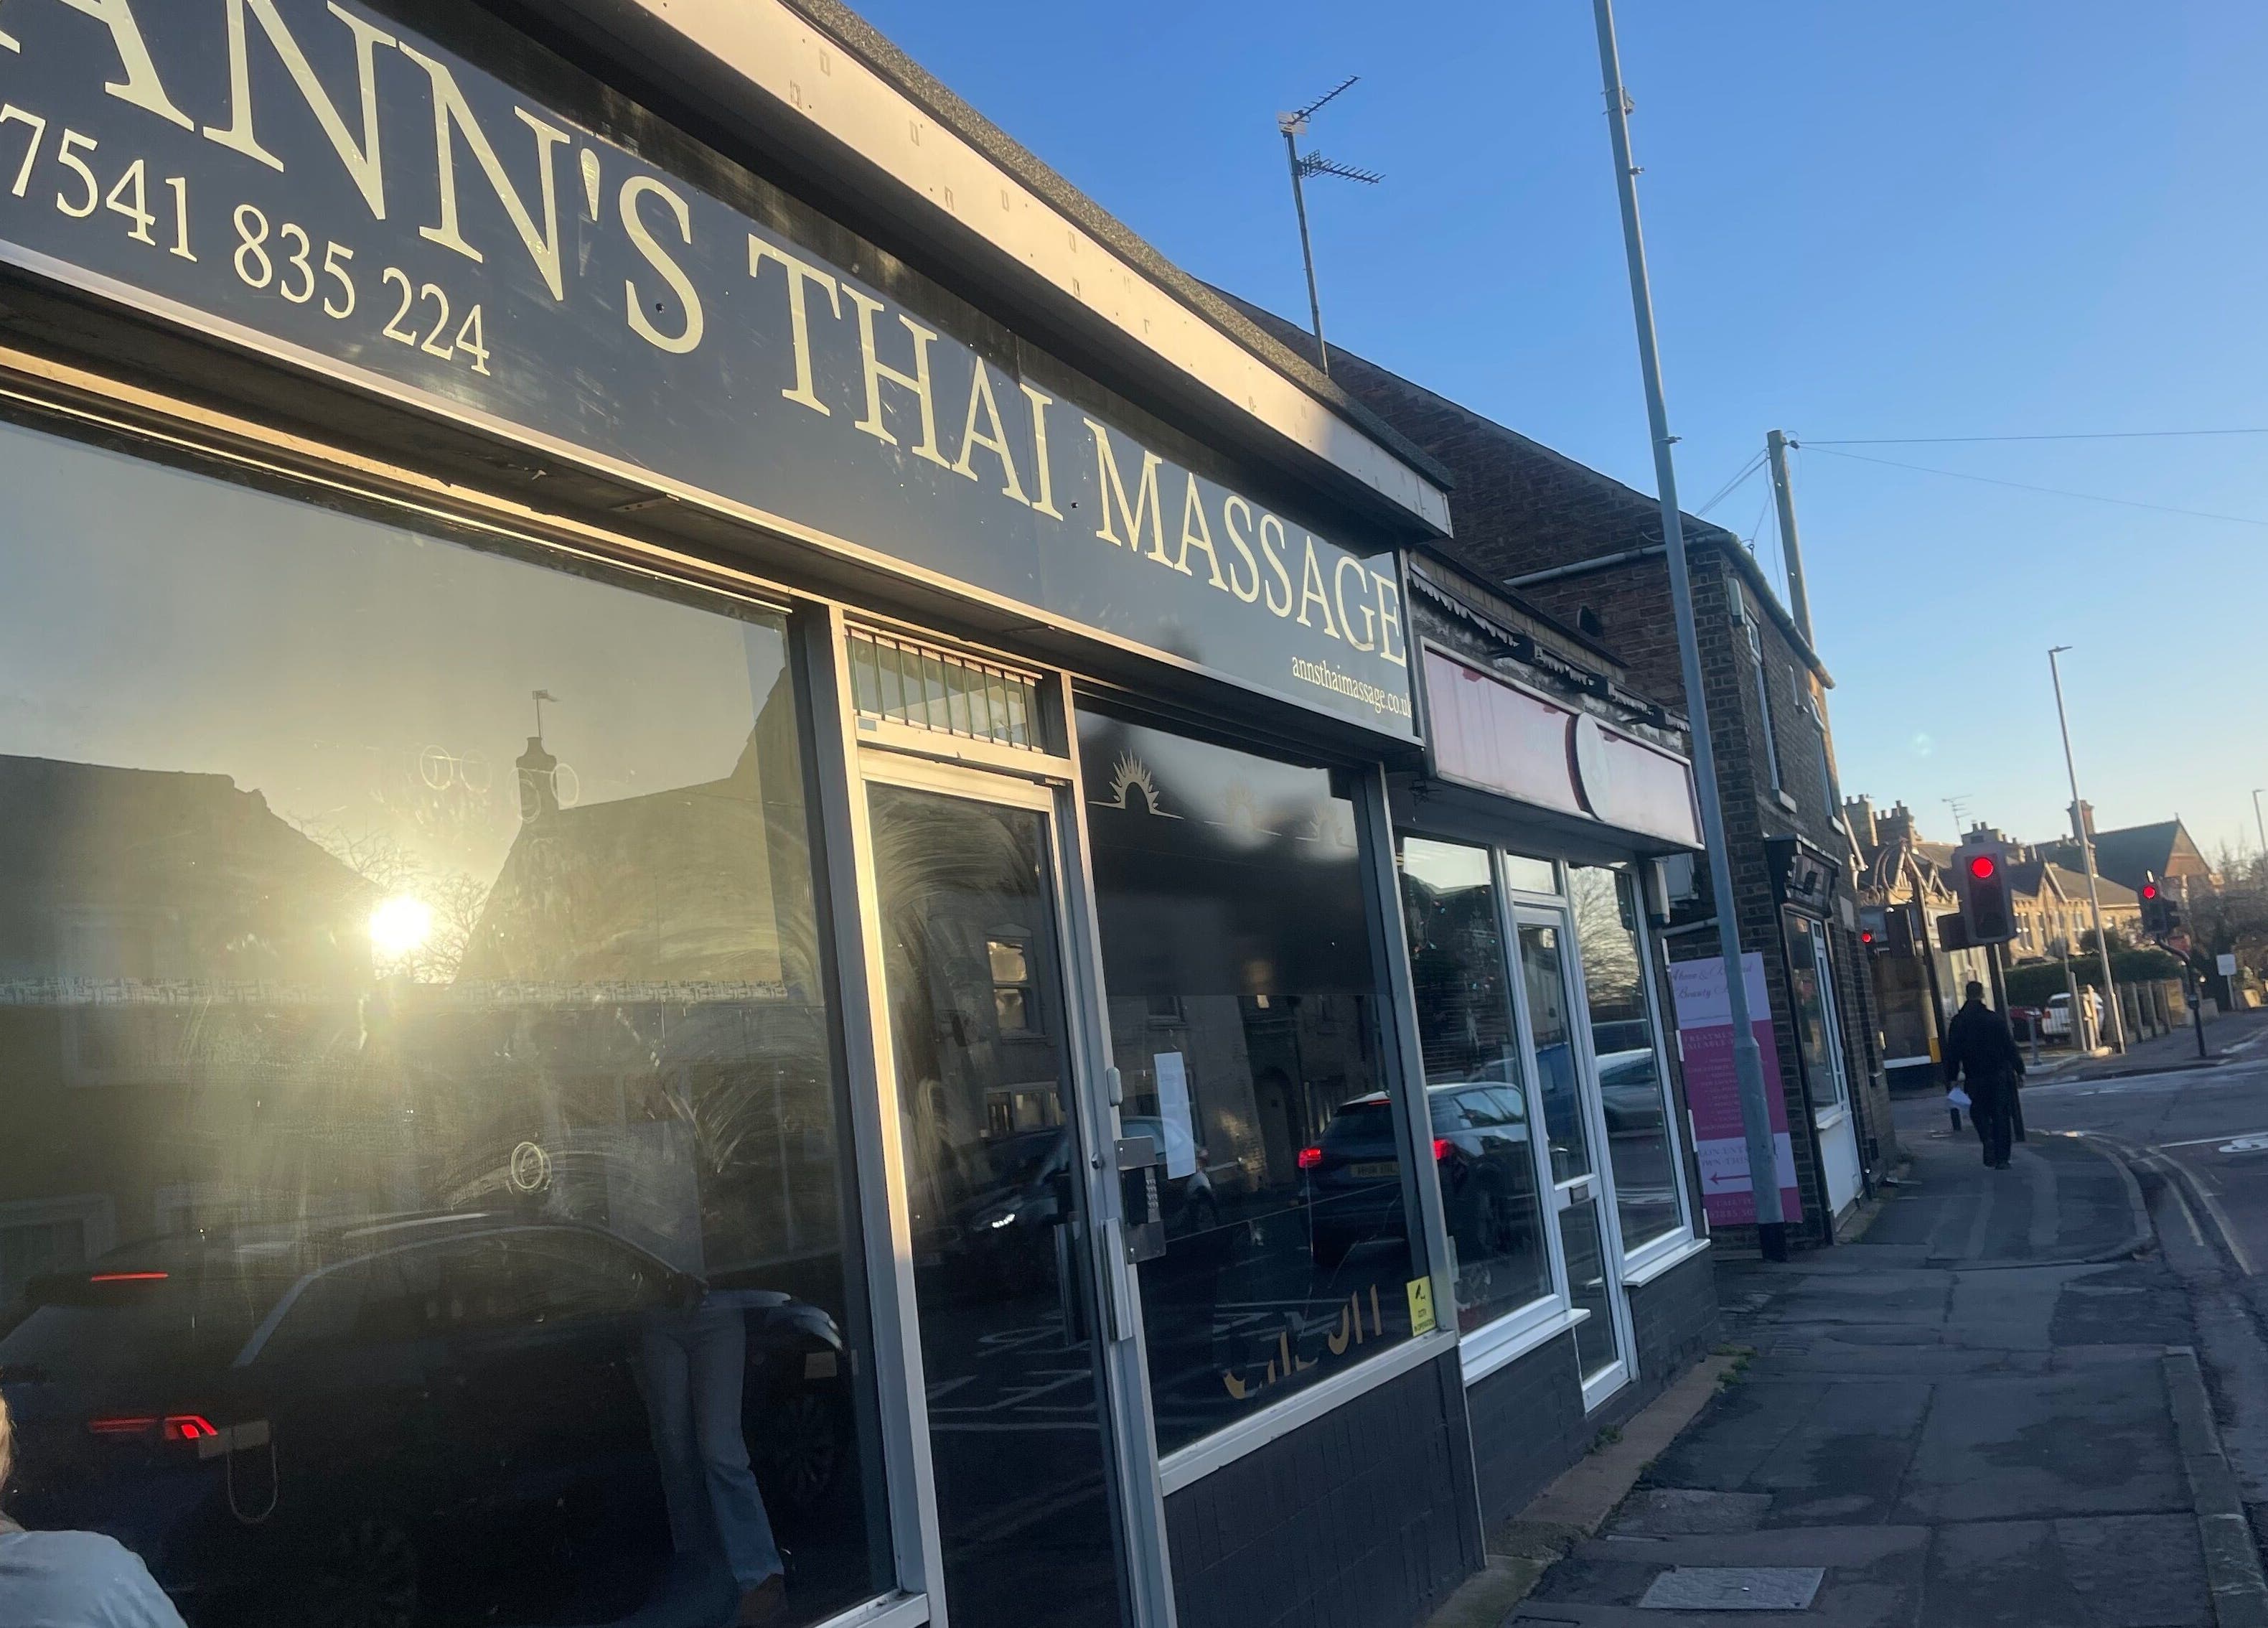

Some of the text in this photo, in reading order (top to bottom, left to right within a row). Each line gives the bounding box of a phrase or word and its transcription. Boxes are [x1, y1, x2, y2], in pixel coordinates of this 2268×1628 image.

[0, 104, 491, 376] 7541 835 224
[747, 233, 1064, 522] THAI
[1084, 418, 1407, 668] MASSAGE
